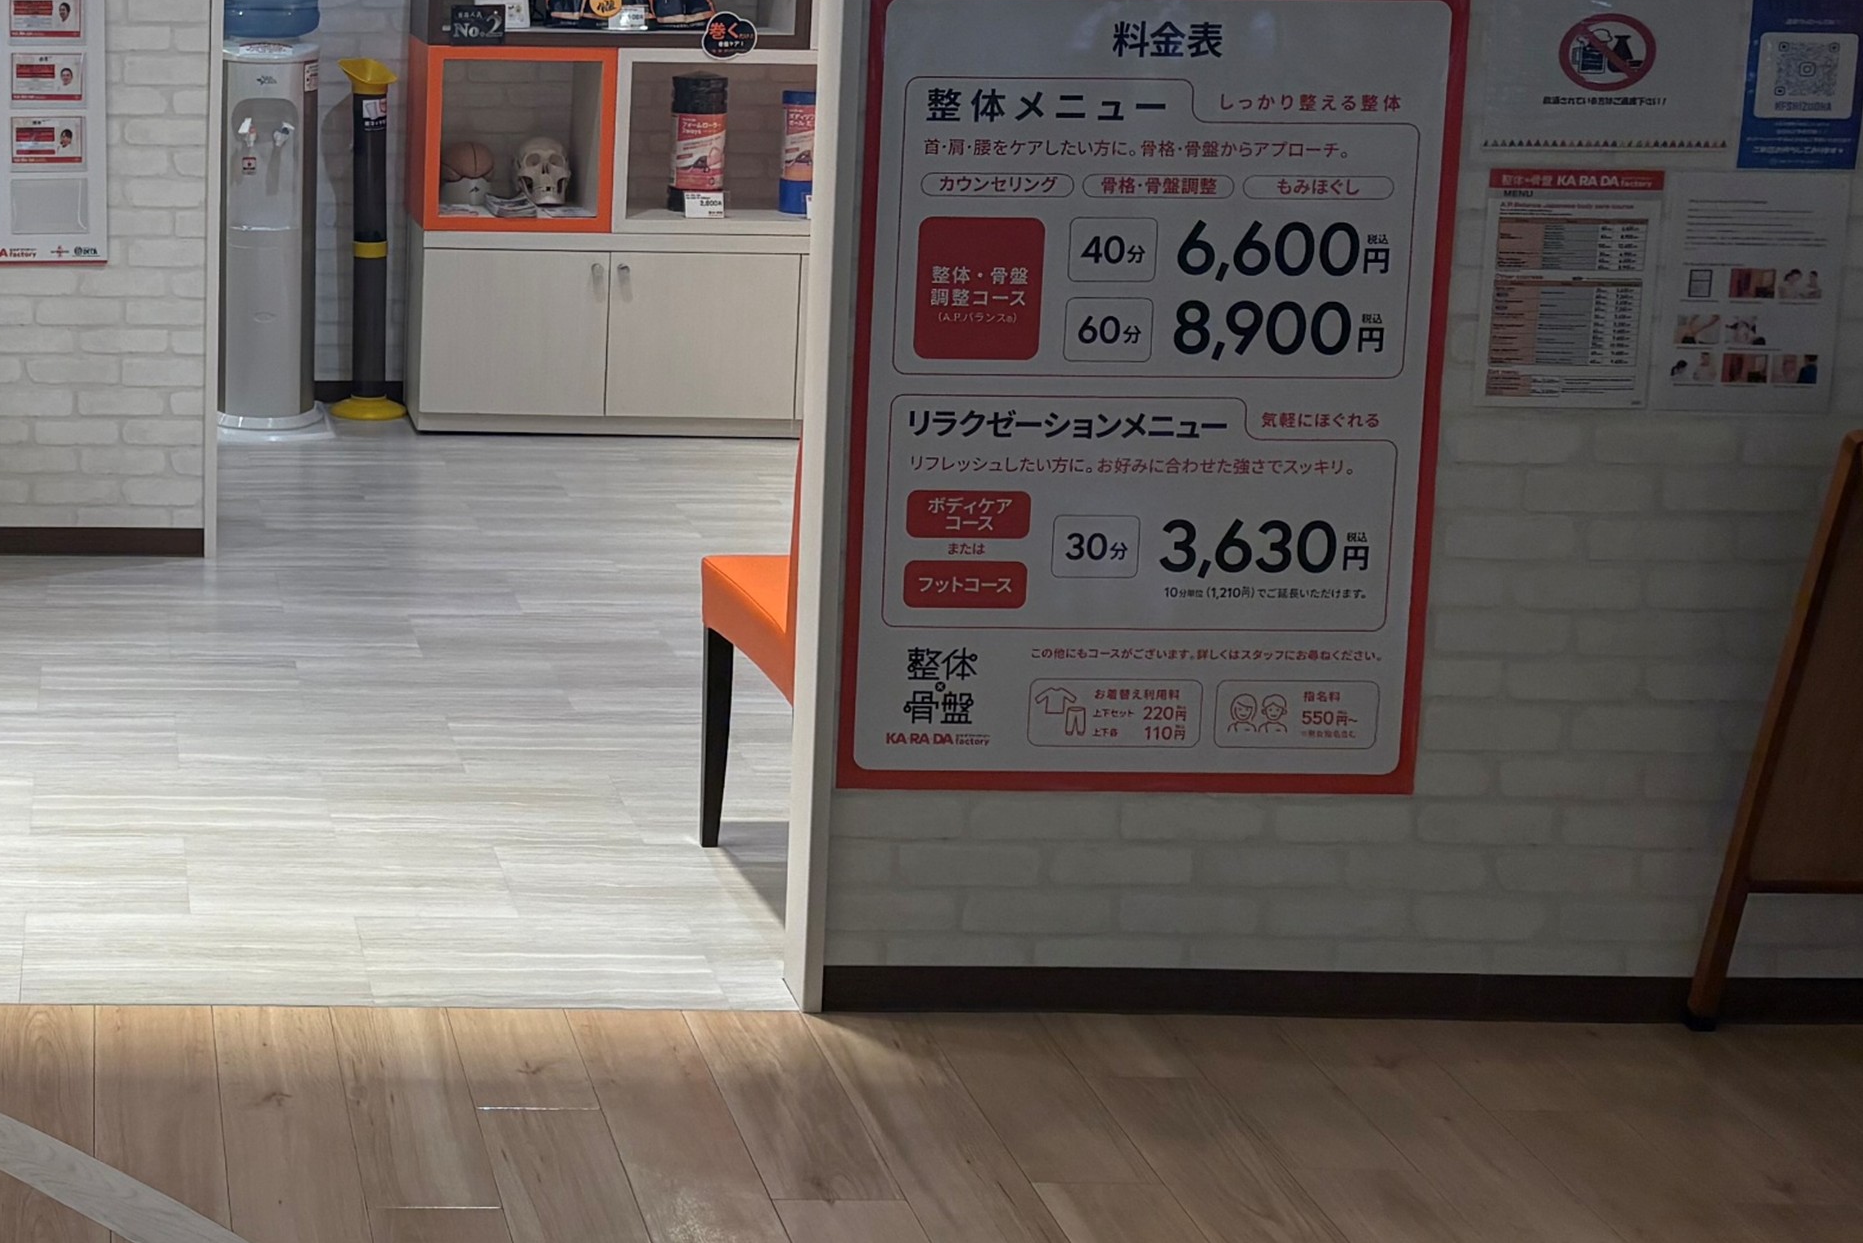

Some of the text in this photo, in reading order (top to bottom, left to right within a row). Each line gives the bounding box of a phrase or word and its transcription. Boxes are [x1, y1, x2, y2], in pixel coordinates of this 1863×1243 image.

[1113, 22, 1223, 57] 料金表
[927, 88, 1166, 122] 整体メニュー
[1219, 93, 1401, 112] しっかり整える整体
[940, 176, 1057, 194] カウンセリング
[1101, 177, 1217, 195] 骨格・骨盤調整
[1276, 178, 1360, 195] もみほぐし
[1081, 236, 1145, 264] 40分
[932, 266, 1028, 284] 整体・骨盤
[930, 289, 1025, 306] 調整コース
[1077, 316, 1142, 345] 60分
[909, 410, 1227, 439] リラクゼーションメニュー
[1261, 412, 1379, 428] 気軽にほぐれる
[928, 497, 1012, 514] ボディケア
[945, 515, 993, 531] コース
[947, 542, 985, 555] または
[1066, 532, 1128, 561] 30分
[918, 576, 1012, 593] フットコース
[907, 647, 977, 680] 整体
[1304, 691, 1340, 702] 指名料
[903, 691, 974, 724] 骨盤
[1093, 709, 1135, 718] 上下セット
[956, 735, 990, 746] factory
